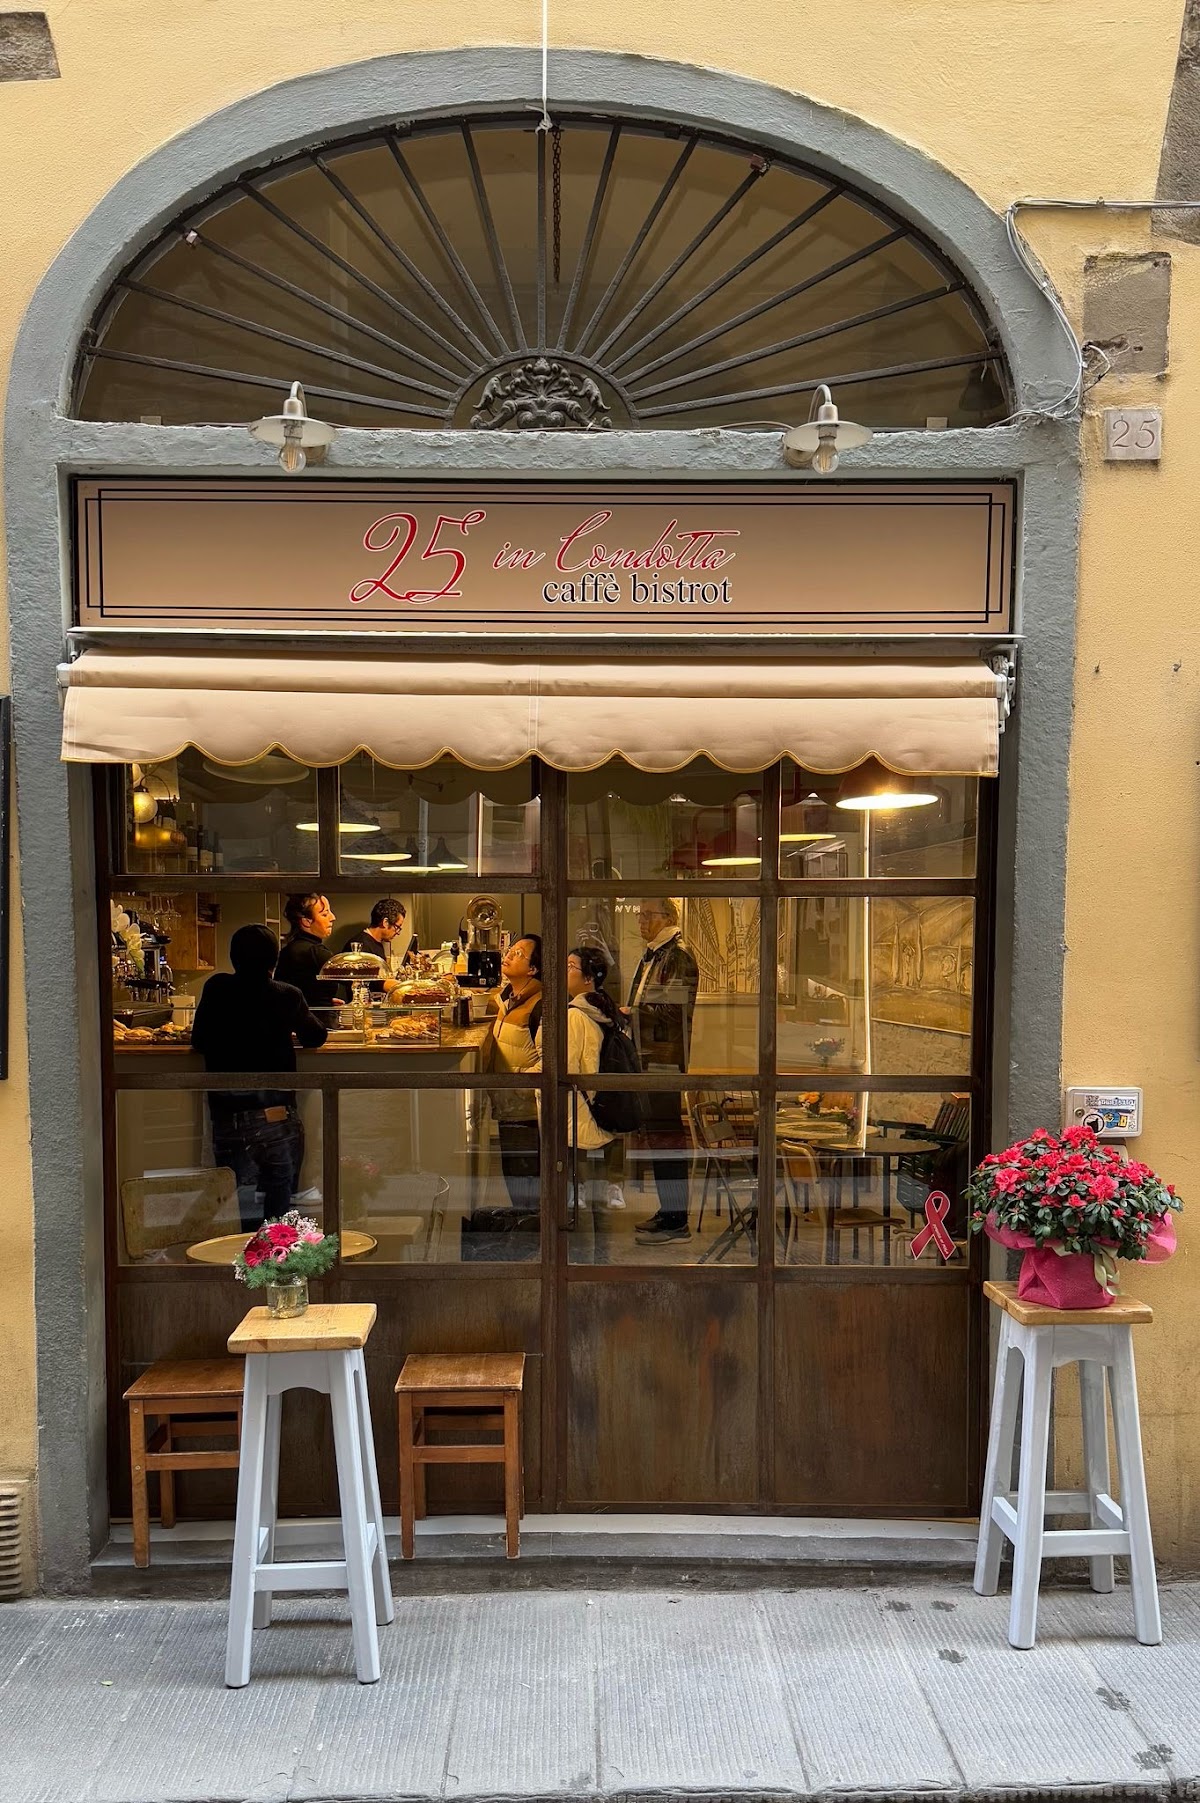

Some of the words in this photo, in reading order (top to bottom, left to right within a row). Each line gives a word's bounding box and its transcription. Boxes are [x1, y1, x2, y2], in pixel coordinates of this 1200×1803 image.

[1112, 417, 1157, 448] 25
[350, 510, 486, 604] 25
[493, 542, 545, 570] in
[555, 510, 740, 572] Condotta
[542, 572, 620, 604] caffè
[630, 572, 732, 604] bistrot
